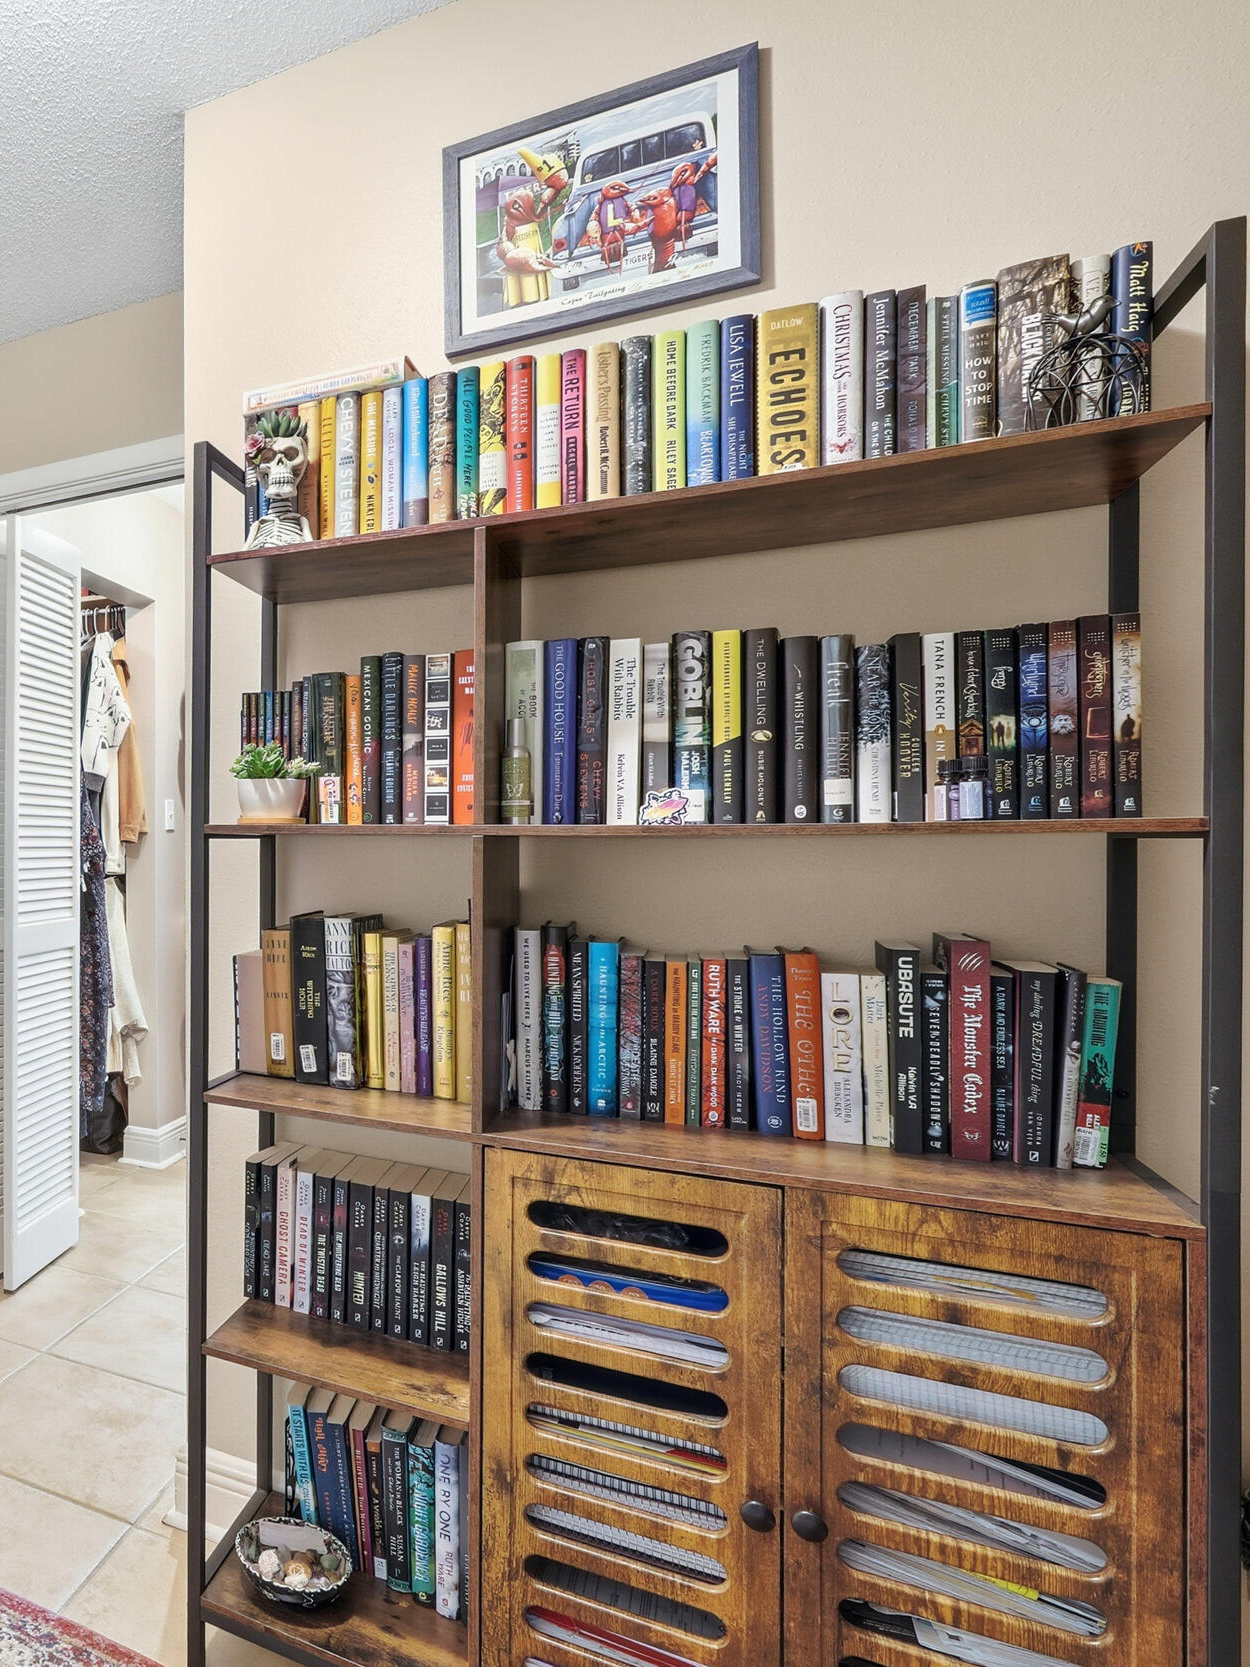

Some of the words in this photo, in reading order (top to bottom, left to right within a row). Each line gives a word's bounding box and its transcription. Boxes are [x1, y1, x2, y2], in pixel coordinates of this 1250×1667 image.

[1128, 260, 1149, 298] Matt
[770, 316, 803, 330] DATLOW
[873, 297, 889, 346] Jennifer
[908, 301, 919, 351] DECEMBER
[1121, 303, 1149, 333] Haig
[666, 341, 676, 366] HOME
[700, 333, 711, 374] FREDRIK
[729, 324, 744, 355] LISA
[832, 304, 853, 380] CHRISTMAS
[566, 358, 577, 376] THE
[909, 355, 918, 380] PARK
[942, 345, 950, 385] MISSING
[965, 357, 993, 369] HOW
[971, 370, 988, 381] TO
[463, 376, 473, 395] ALL
[666, 368, 676, 403] BEFORE
[728, 358, 744, 407] JEWELL
[875, 350, 889, 410] McMahon
[964, 382, 993, 396] STOP
[462, 400, 473, 424] GOOD
[519, 377, 528, 434] THIRTEEN
[565, 378, 580, 431] RETURN
[769, 347, 807, 466] ECHOES
[836, 394, 848, 438] HORRORS
[941, 393, 950, 424] CHEVY
[965, 395, 993, 408] TIME
[340, 397, 354, 453] CHEVY
[666, 405, 676, 431] DARK
[871, 421, 878, 432] ON
[884, 414, 892, 426] THE
[463, 428, 473, 461] PEOPLE
[666, 440, 676, 464] RILEY
[464, 464, 472, 487] HERE
[756, 638, 764, 658] THE
[934, 640, 945, 671] TANA
[384, 655, 402, 689] LITTLE
[554, 662, 564, 700] GOOD
[587, 655, 596, 694] THOSE
[613, 658, 624, 683] With
[626, 658, 636, 678] The
[867, 657, 880, 689] NEAR
[363, 665, 371, 711] MEXICAN
[626, 679, 636, 719] Trouble
[675, 639, 703, 748] GOBLIN
[756, 662, 766, 726] DWELLING
[827, 661, 851, 709] freak
[869, 690, 879, 706] THE
[935, 677, 945, 720] FRENCH
[384, 693, 395, 741] DARLINGS
[529, 694, 538, 719] BOOK
[586, 699, 596, 734] GIRLS
[613, 685, 624, 721] Rabbits
[898, 682, 919, 730] Verity
[363, 716, 372, 754] GOTHIC
[554, 703, 564, 744] HOUSE
[794, 692, 804, 750] WHISTLING
[723, 750, 732, 767] PAUL
[899, 733, 911, 779] HOOVER
[936, 740, 946, 752] IN
[617, 753, 625, 778] Kelvin
[691, 751, 700, 775] JOSH
[592, 760, 601, 800] CHEVY
[554, 794, 563, 811] Due
[442, 941, 453, 973] Anne
[442, 975, 453, 1002] Rice
[598, 965, 607, 1019] HAUNTING
[708, 964, 721, 998] RUTH
[771, 976, 781, 1002] THE
[734, 986, 743, 1014] STROKE
[794, 990, 813, 1031] THE
[898, 957, 914, 1038] UBASUTE
[960, 985, 983, 1012] The
[1097, 991, 1109, 1007] THE
[708, 1000, 721, 1034] WARE
[829, 981, 855, 1073] LORE
[1091, 1009, 1107, 1046] HAUNTING
[734, 1024, 743, 1053] WINTER
[773, 1008, 784, 1064] HOLLOW
[962, 1012, 983, 1071] Monster
[1030, 1021, 1044, 1081] DREADFUL
[598, 1040, 607, 1079] ARCTIC
[775, 1069, 786, 1103] KIND
[898, 1072, 907, 1101] Allison
[908, 1066, 918, 1092] Kelvin
[963, 1072, 984, 1117] Codex
[1027, 1083, 1041, 1103] thing
[710, 1086, 718, 1108] WOOD
[278, 1211, 289, 1243] GHOST
[300, 1216, 308, 1239] DEAD
[300, 1243, 308, 1254] OF
[278, 1245, 290, 1285] CAMERA
[298, 1257, 308, 1292] WINTER
[352, 1270, 365, 1305] HUNTED
[435, 1263, 447, 1307] GALLOWS
[434, 1310, 447, 1332] HILL
[292, 1409, 301, 1418] IT
[294, 1419, 306, 1449] STARTS
[297, 1450, 308, 1471] WITH
[355, 1448, 364, 1488] BELOVED
[438, 1453, 451, 1485] ONE
[300, 1472, 309, 1485] US
[395, 1498, 403, 1525] BLACK
[414, 1487, 429, 1523] NIGHT
[439, 1489, 451, 1508] BY
[439, 1510, 451, 1542] ONE
[390, 1535, 398, 1555] HILL
[396, 1534, 404, 1562] SUSAN
[414, 1523, 430, 1582] GARDENER
[445, 1551, 453, 1577] RUTH
